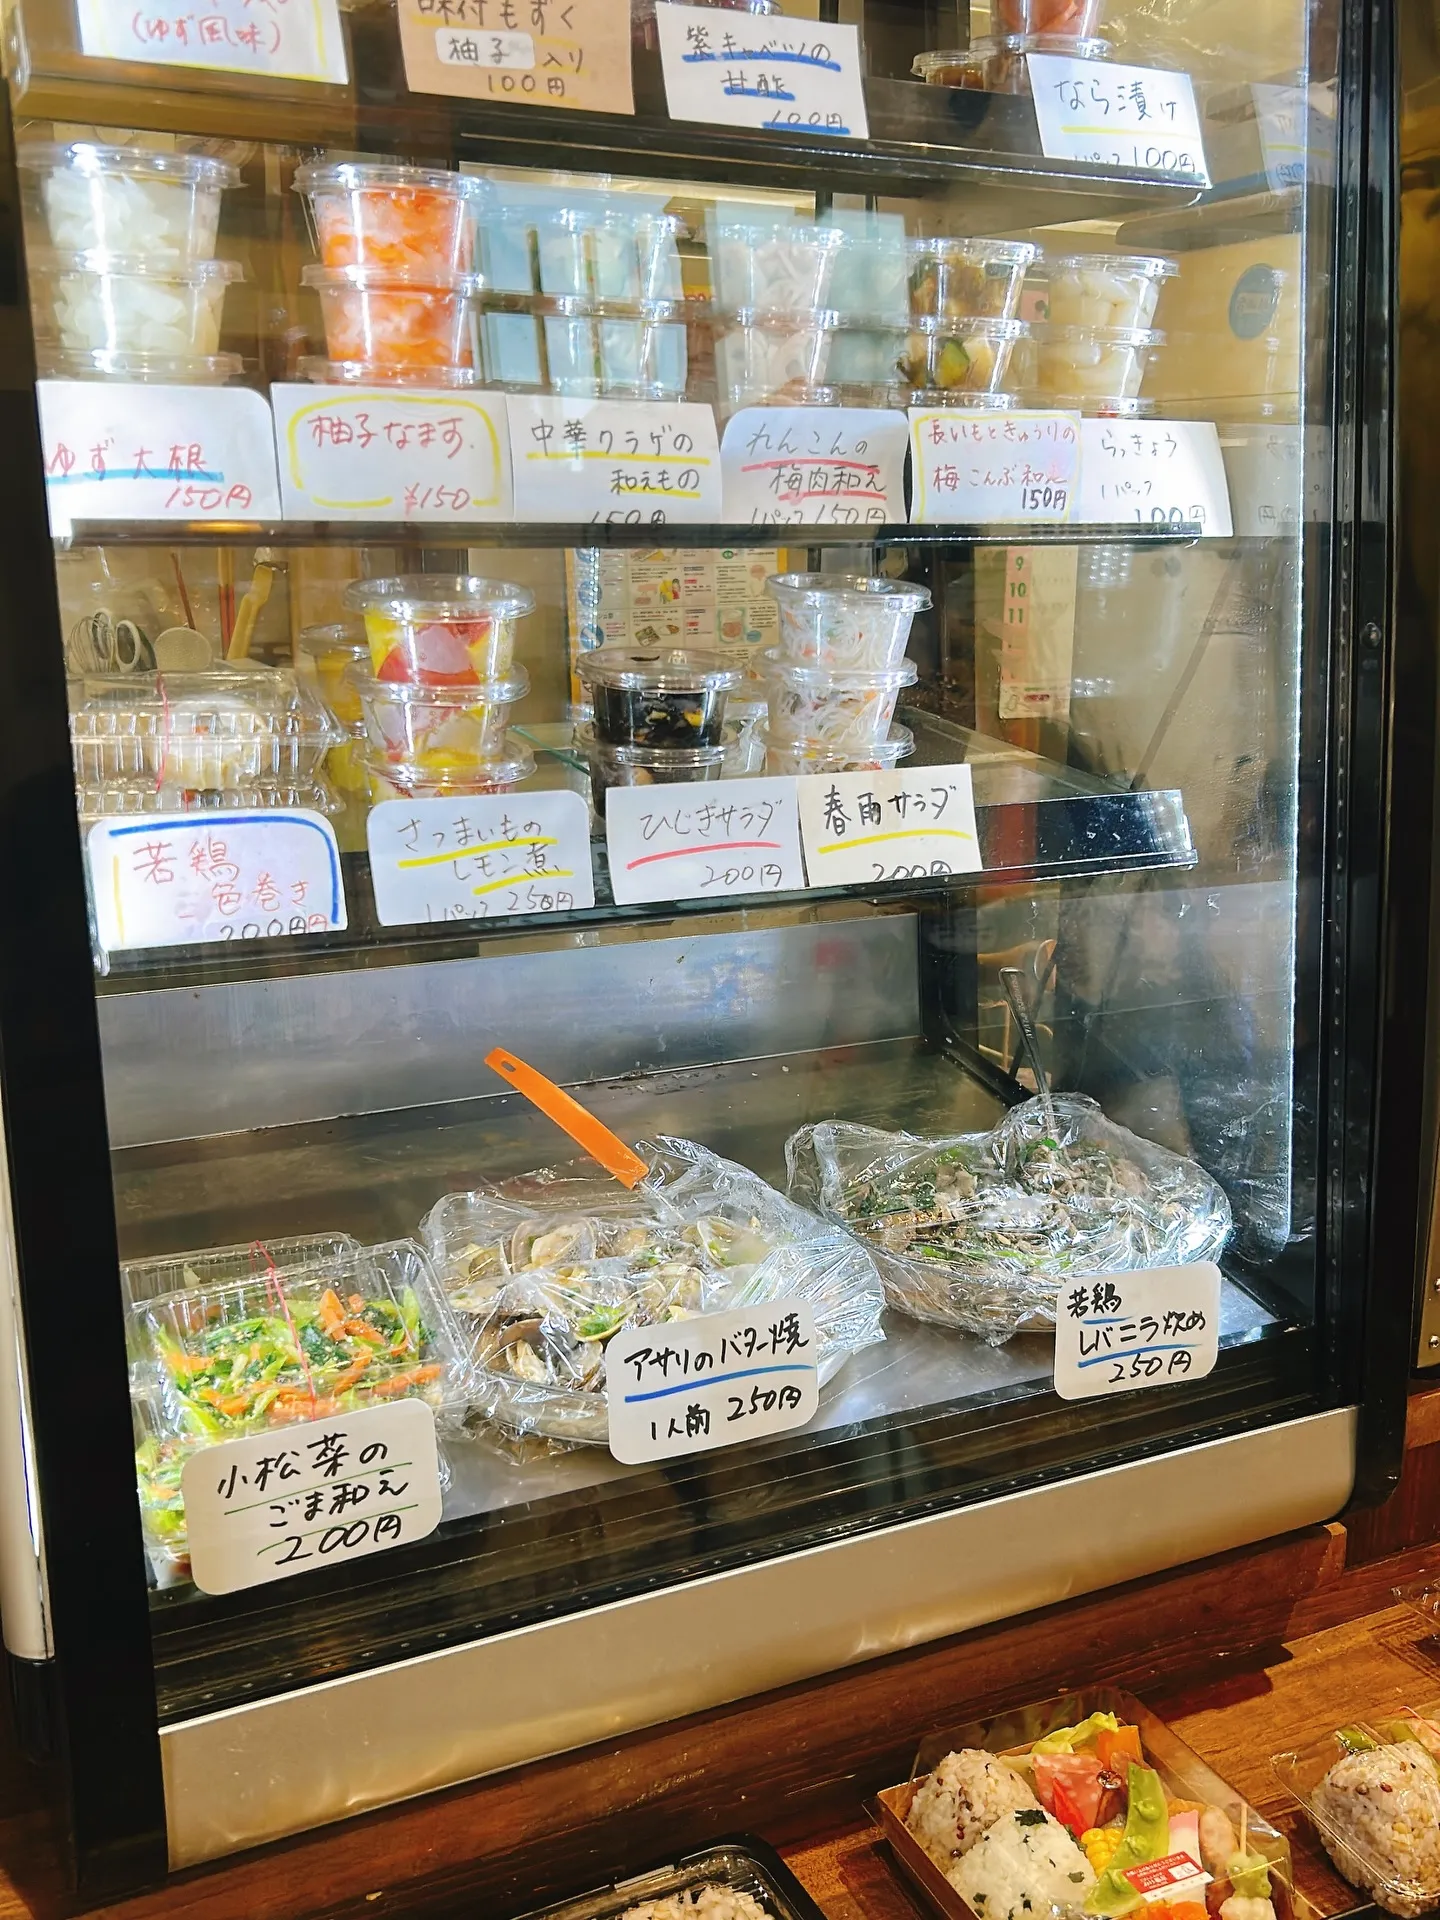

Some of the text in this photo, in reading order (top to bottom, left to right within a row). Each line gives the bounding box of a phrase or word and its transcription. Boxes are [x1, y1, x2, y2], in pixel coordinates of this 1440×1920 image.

[447, 37, 584, 73] 柚子 入り
[686, 25, 831, 64] 紫キャベツの
[487, 74, 566, 98] 100円
[720, 69, 788, 98] 甘酢
[1053, 79, 1177, 121] なら漬け
[770, 109, 843, 129] 100円
[1133, 145, 1196, 173] 100円
[530, 417, 694, 460] 中華クラゲの
[745, 422, 869, 457] れんこんの
[927, 418, 1076, 447] 長いもときゅうりの
[1100, 428, 1178, 458] らっきょう
[43, 436, 214, 483] ゆず大根
[164, 483, 252, 511] 150円
[609, 468, 701, 496] 和えもの
[768, 463, 888, 497] 梅肉和え
[403, 482, 470, 516] ¥150
[1021, 486, 1067, 511] 150円
[1015, 556, 1024, 571] 9
[1009, 582, 1026, 598] 10
[1008, 607, 1025, 624] 11
[639, 799, 783, 841] ひじきサラダ
[823, 784, 957, 837] 春雨サラダ
[132, 835, 240, 885] 若鶏
[453, 842, 560, 881] レモン煮
[699, 863, 783, 888] 200円
[1066, 1282, 1123, 1319] 若鶏
[623, 1312, 810, 1382] アサリのバター焼
[1078, 1309, 1206, 1356] レバニラ炒め
[1107, 1350, 1192, 1383] 250円
[650, 1385, 803, 1441] 1人前 250円
[217, 1432, 389, 1499] 小松菜の
[269, 1469, 410, 1528] ごま和え
[274, 1513, 402, 1566] 200円
